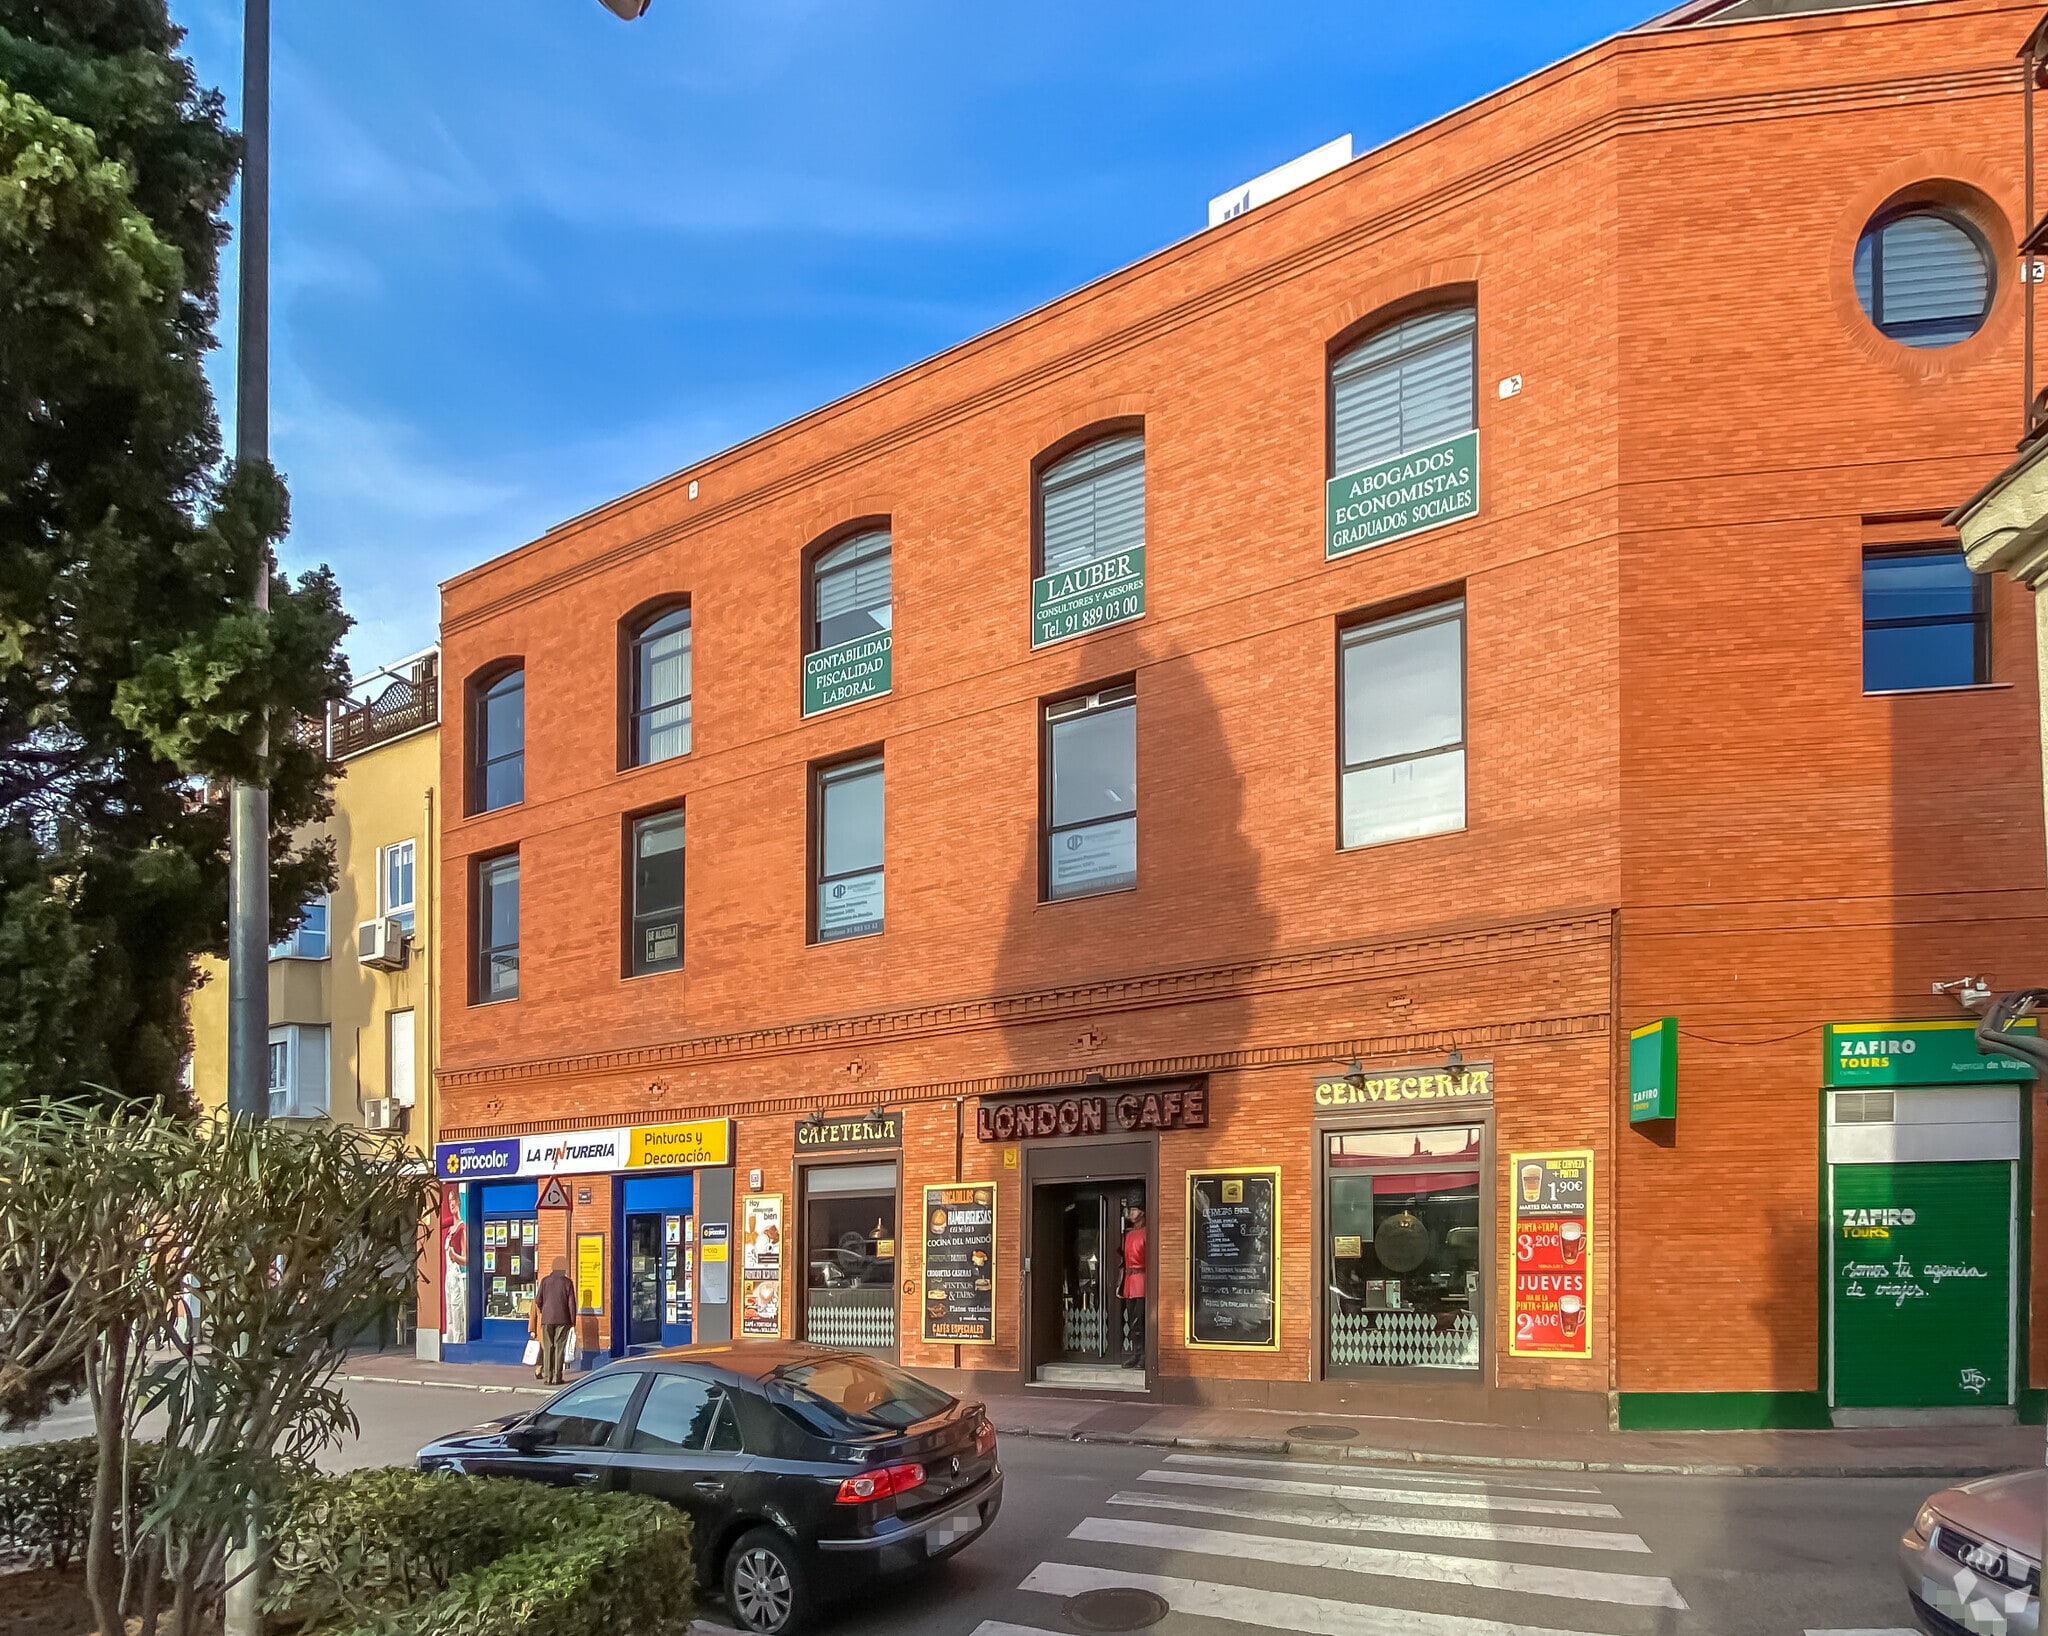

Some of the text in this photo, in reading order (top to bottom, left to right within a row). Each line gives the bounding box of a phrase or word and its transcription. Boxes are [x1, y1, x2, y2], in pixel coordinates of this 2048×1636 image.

[1349, 448, 1455, 498] ABOGADOS
[1335, 467, 1470, 525] ECONOMISTAS
[1333, 489, 1472, 548] GRADUADOS SOCIALES
[1047, 554, 1133, 601] LAUBER
[1037, 579, 1144, 620] CONSULTORES Y ASESORES
[1042, 595, 1138, 639] Tel. 91 889 03 00
[807, 636, 893, 674] CONTABILIDAD
[816, 657, 884, 690] FISCALIDAD
[822, 678, 876, 705] LABORAL
[1840, 1039, 1917, 1056] ZAFIRO
[1840, 1056, 1890, 1069] TOURS
[1986, 1061, 1999, 1069] de
[1633, 1088, 1658, 1103] ZAFIRO
[977, 1097, 1105, 1141] LONDON
[644, 1131, 703, 1146] Pinturas y
[460, 1150, 510, 1174] procolor
[526, 1140, 615, 1170] LA PINTURERIA
[643, 1147, 711, 1165] Decoración
[749, 1200, 760, 1208] Hoy
[947, 1209, 992, 1226] HAMBURGUESAS
[1842, 1208, 1916, 1226] ZAFIRO
[1842, 1226, 1890, 1238] TOURS
[927, 1236, 992, 1247] COCINA DEL MUNDO
[926, 1269, 972, 1278] CROQUETAS CASERAS
[1893, 1255, 1914, 1278] tu
[1923, 1261, 1988, 1284] agencia
[1518, 1275, 1583, 1291] JUEVES
[1846, 1281, 1866, 1296] de
[951, 1323, 984, 1334] ESPECIALES
